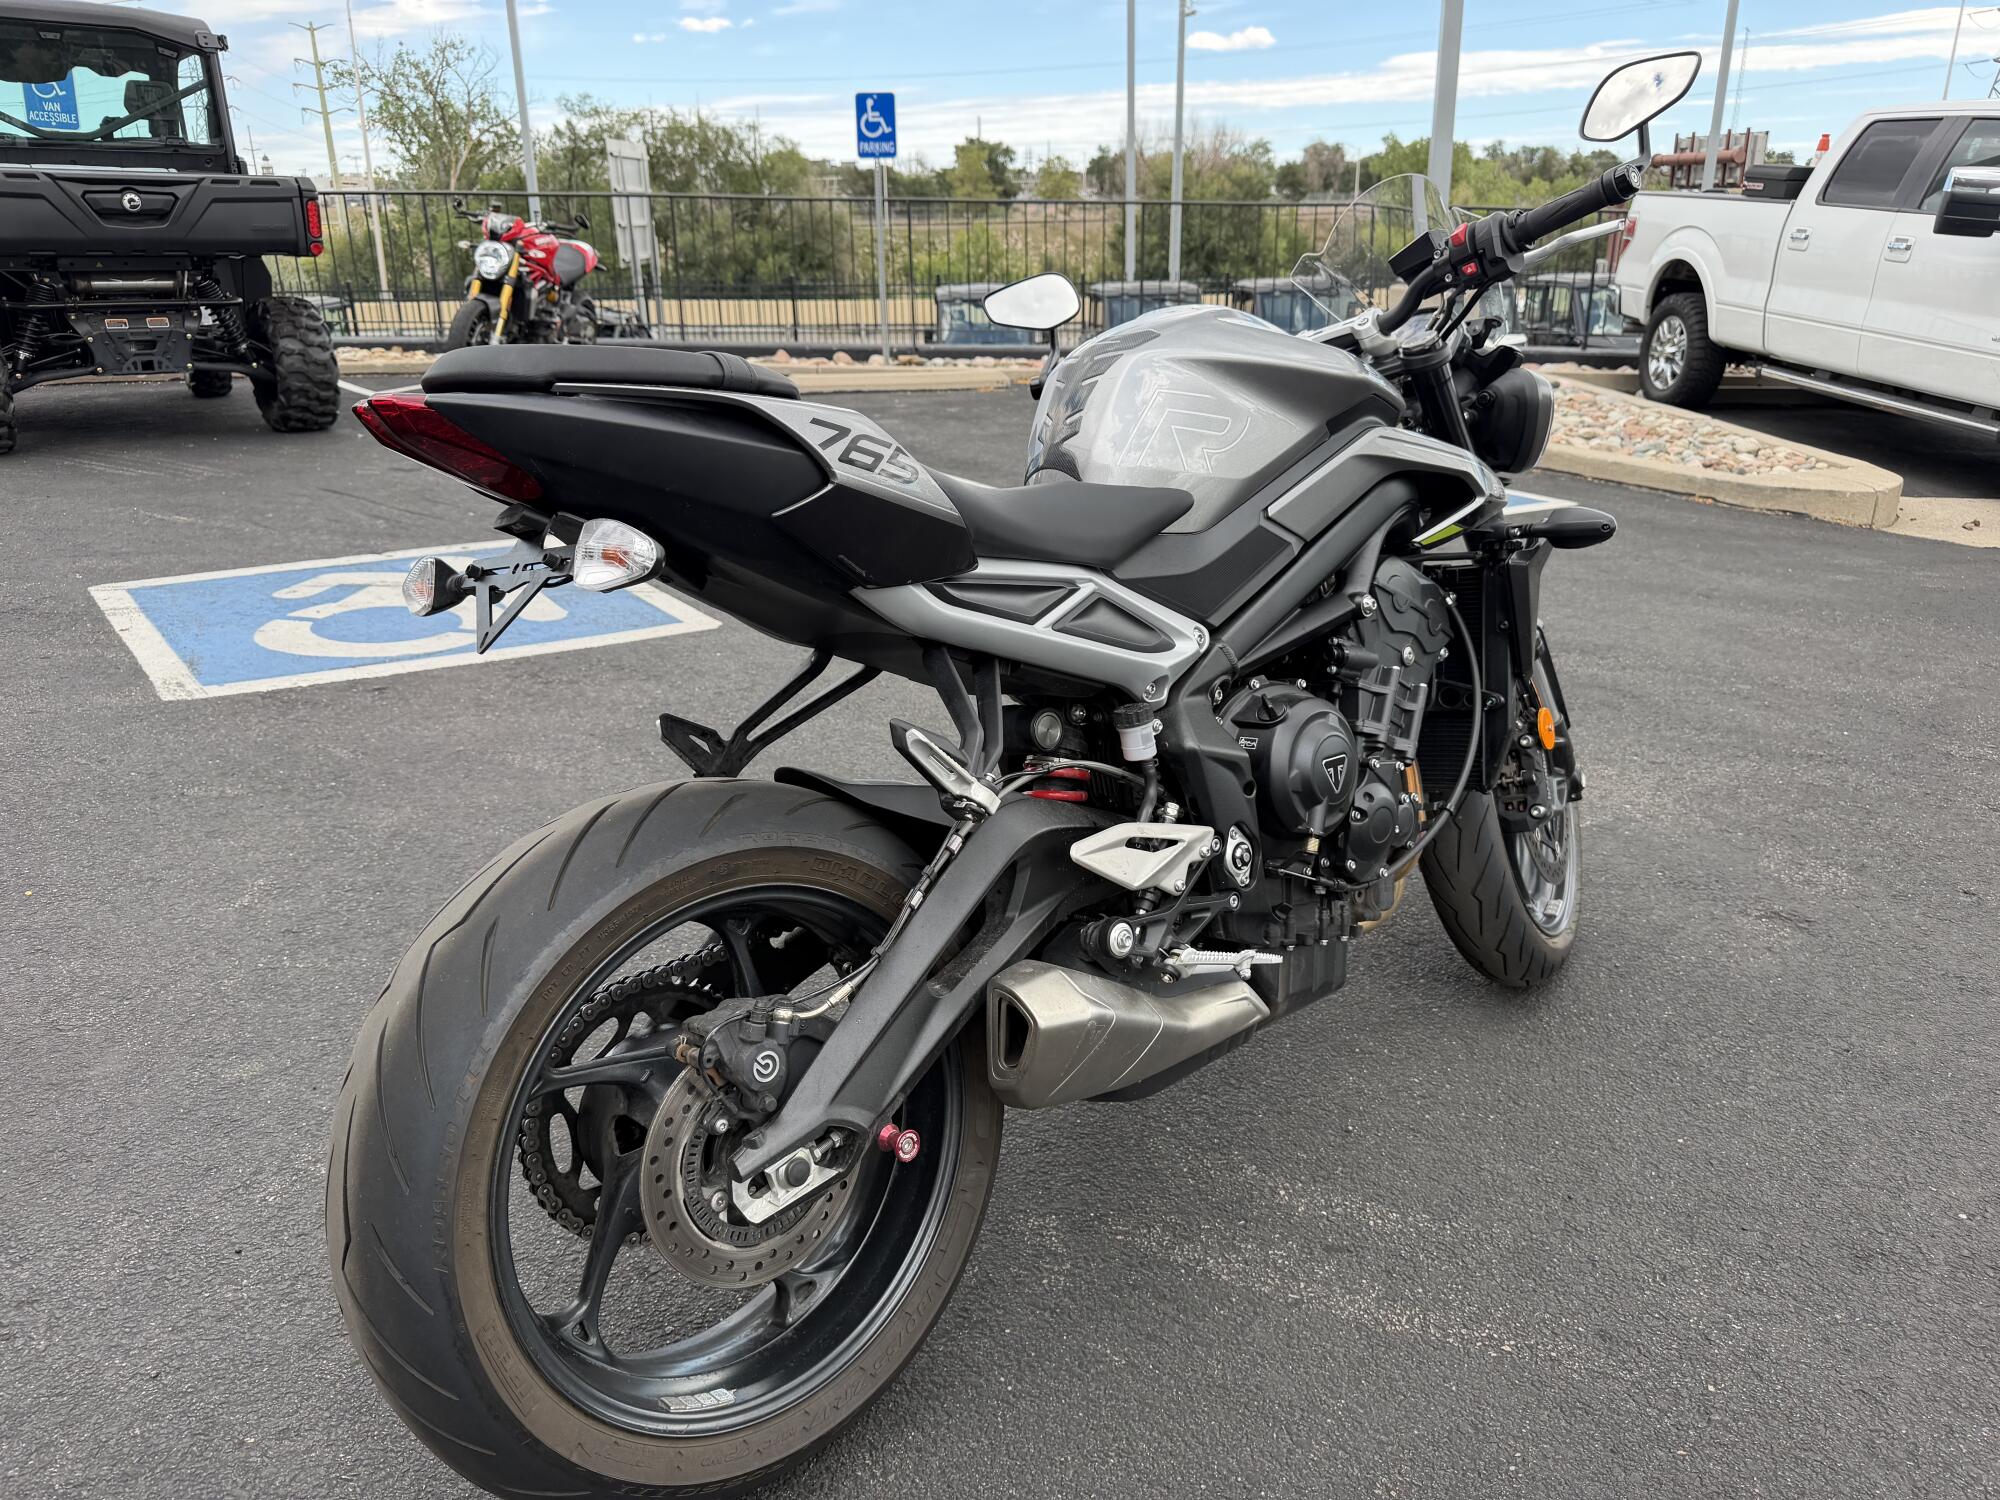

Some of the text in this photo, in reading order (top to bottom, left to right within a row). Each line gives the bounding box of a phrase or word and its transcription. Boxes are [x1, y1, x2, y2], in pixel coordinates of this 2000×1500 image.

[42, 101, 61, 112] VAN
[29, 110, 78, 124] ACCESSIBLE
[809, 416, 920, 485] 765
